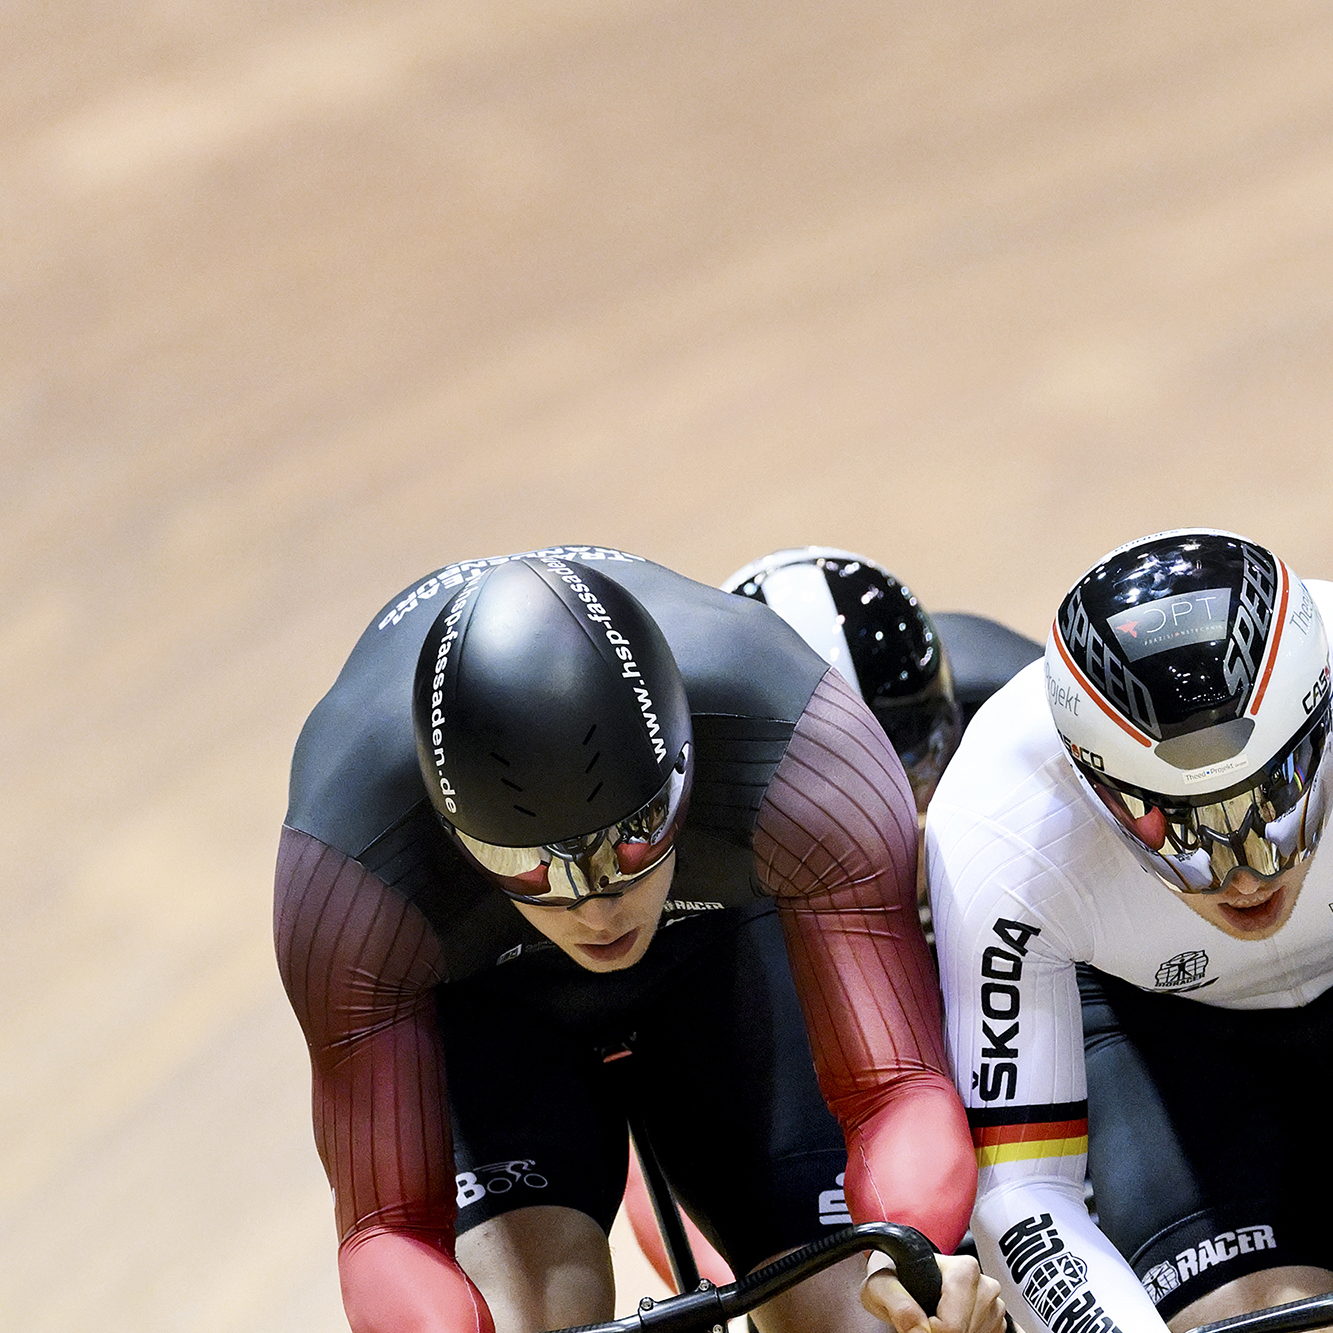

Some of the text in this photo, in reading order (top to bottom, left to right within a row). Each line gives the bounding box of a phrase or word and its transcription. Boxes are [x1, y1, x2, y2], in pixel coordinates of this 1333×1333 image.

[1302, 667, 1330, 714] CAS
[972, 917, 1042, 1101] ŠKODA
[1175, 1224, 1278, 1283] RACER
